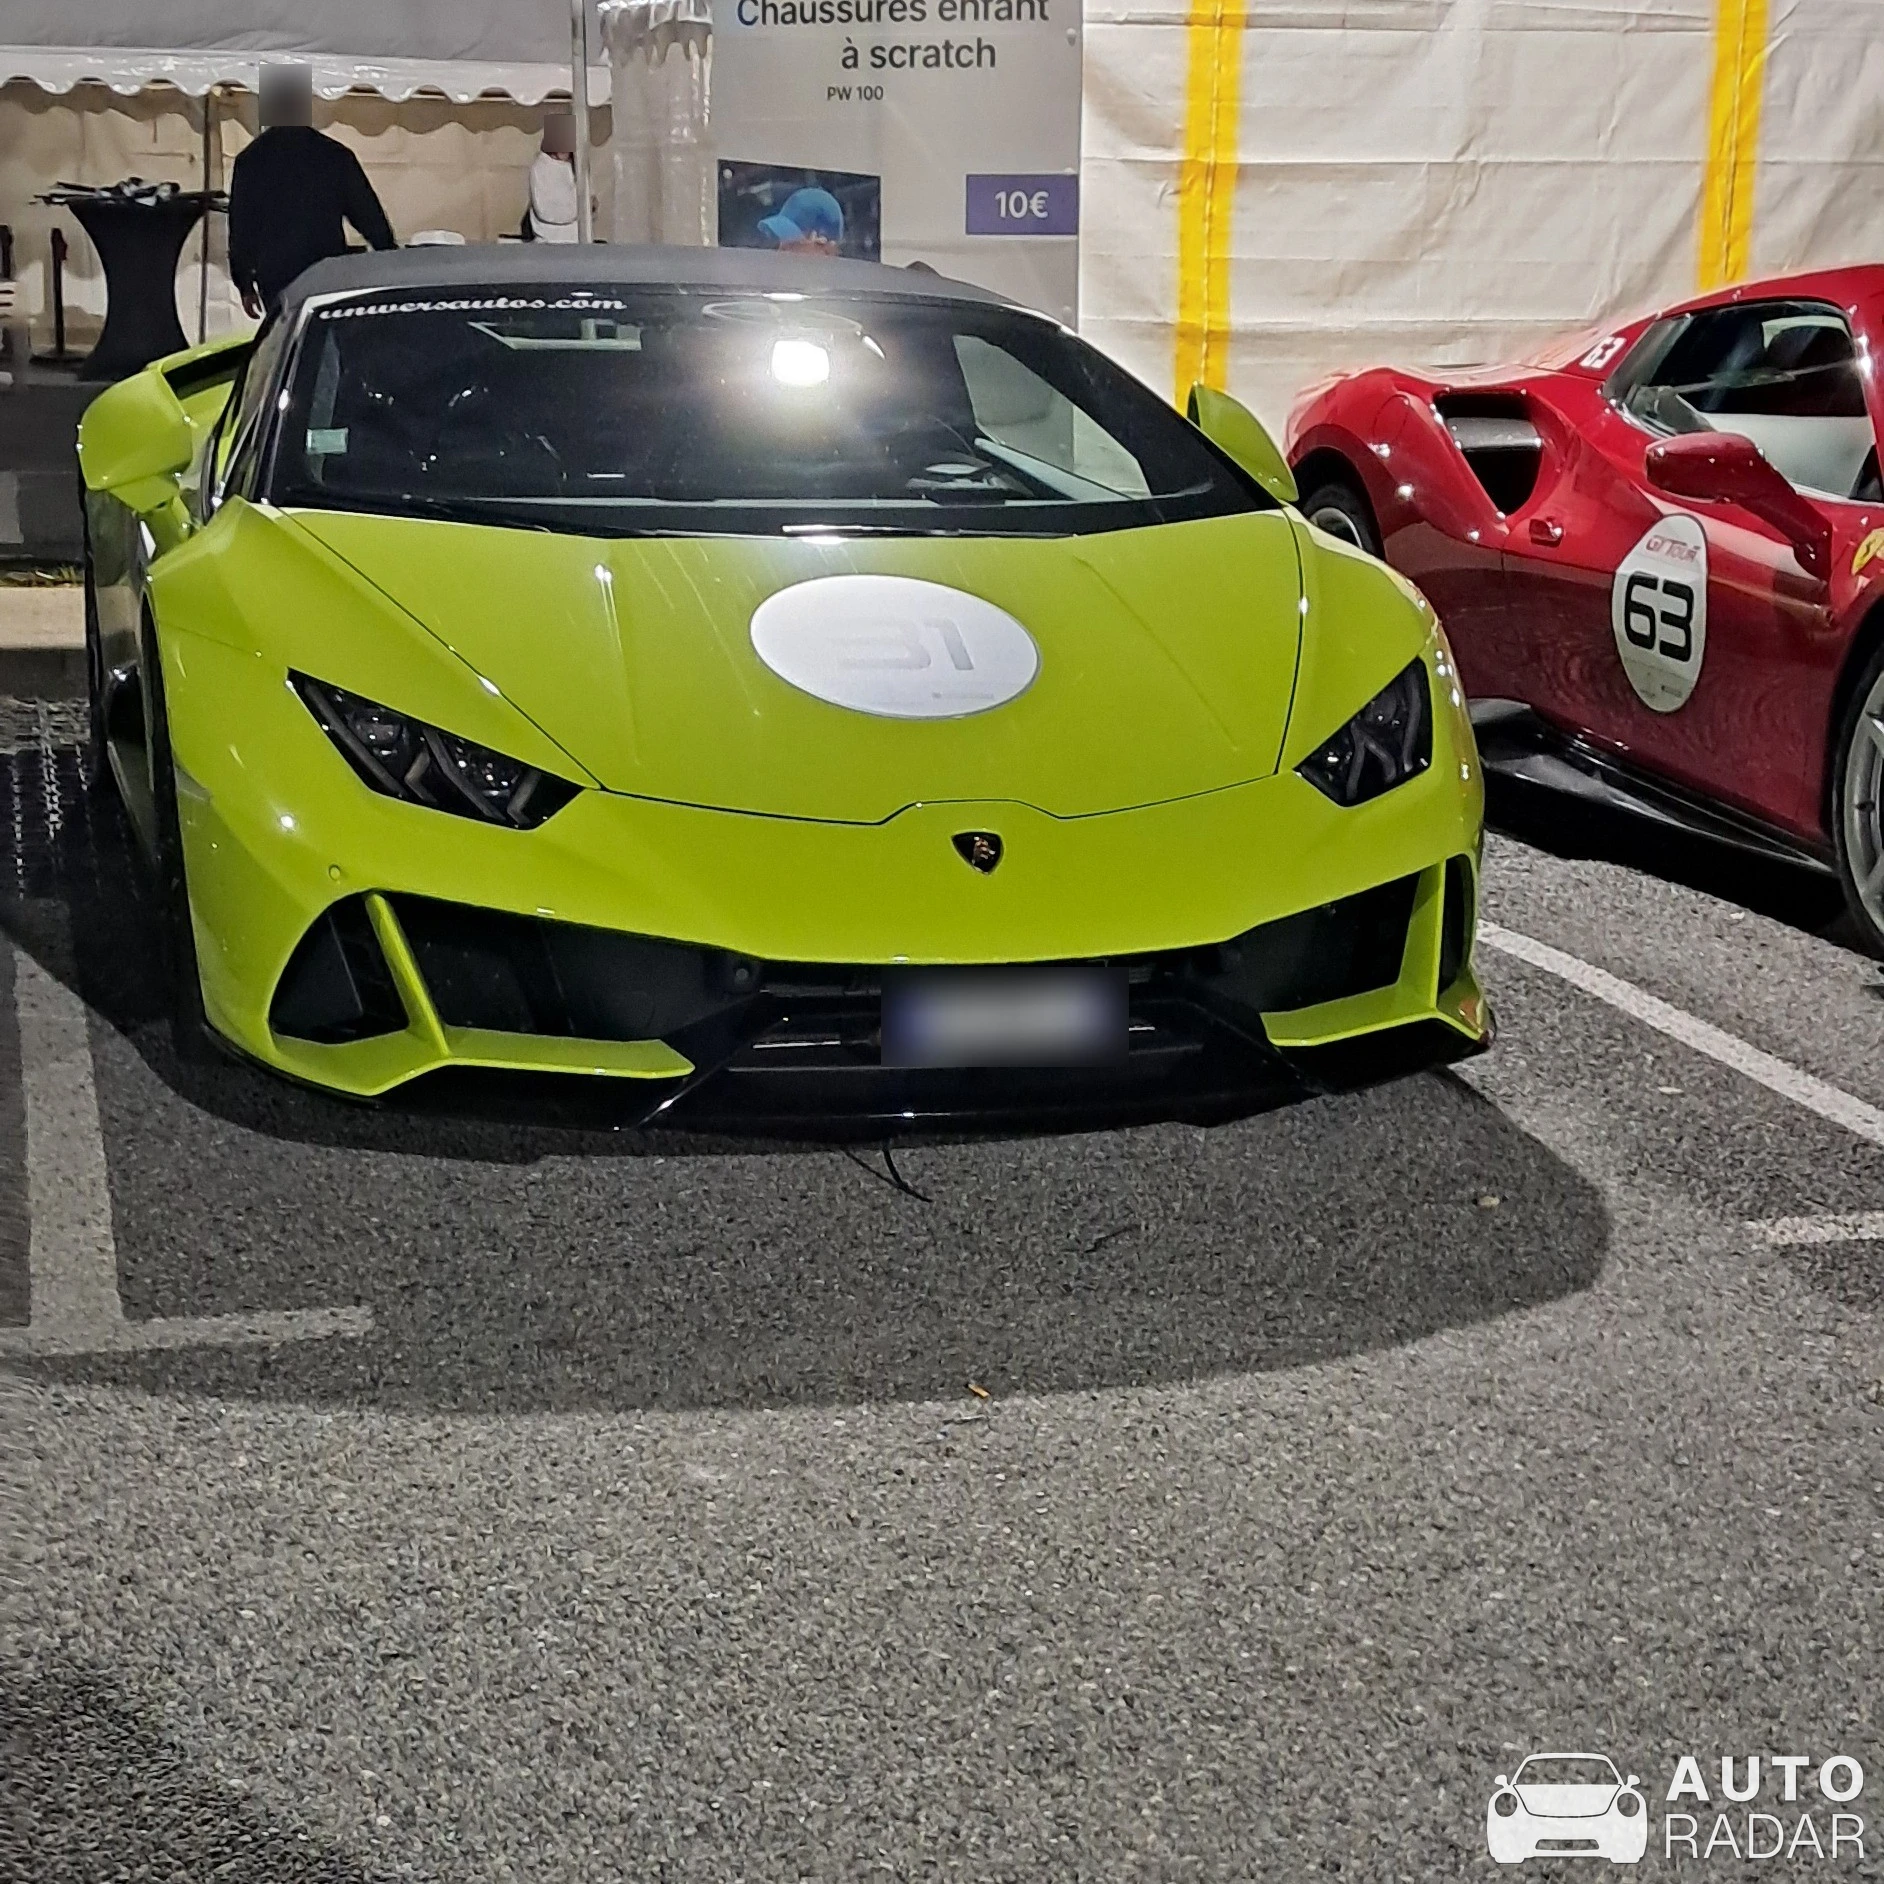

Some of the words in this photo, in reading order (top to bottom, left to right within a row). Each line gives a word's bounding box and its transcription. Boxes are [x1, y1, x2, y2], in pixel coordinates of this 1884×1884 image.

[737, 0, 928, 26] Chaussures
[937, 0, 1050, 22] enfant
[840, 37, 859, 70] à
[869, 37, 997, 70] scratch
[827, 87, 852, 100] PW
[857, 85, 884, 101] 100
[994, 191, 1050, 219] 10€
[1623, 571, 1695, 663] 63
